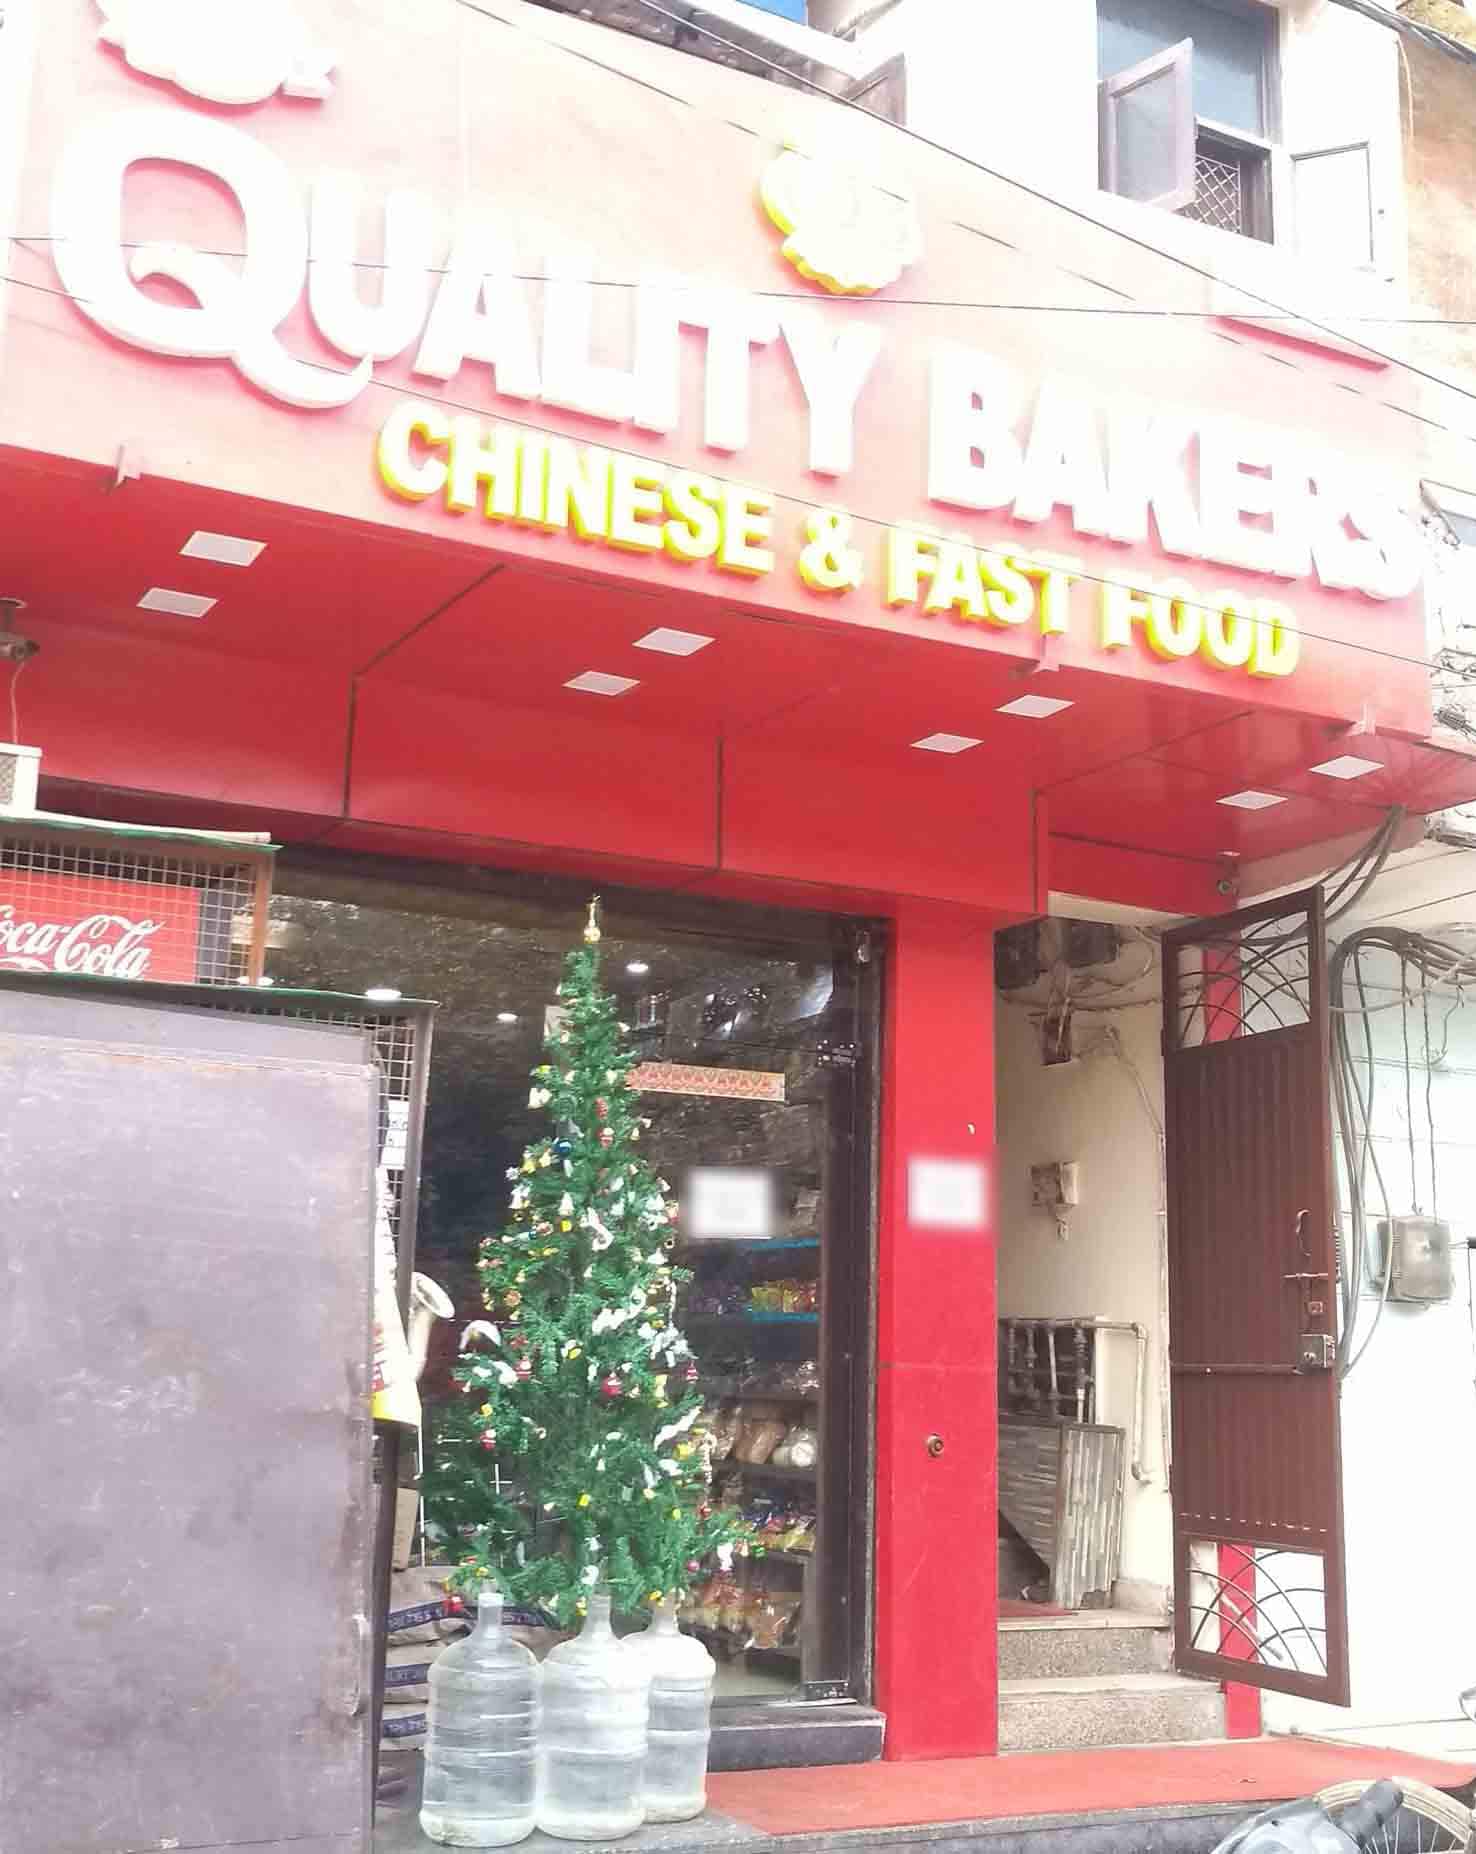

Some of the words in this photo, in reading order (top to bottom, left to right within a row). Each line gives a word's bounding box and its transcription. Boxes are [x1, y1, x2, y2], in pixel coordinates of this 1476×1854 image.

[52, 109, 884, 476] QUALITY
[927, 342, 1425, 600] BAKERS
[377, 399, 775, 575] CHINESE
[799, 508, 863, 594] &
[886, 525, 1080, 638] FAST
[1101, 572, 1302, 680] FOOD
[0, 904, 166, 980] oca-Cola
